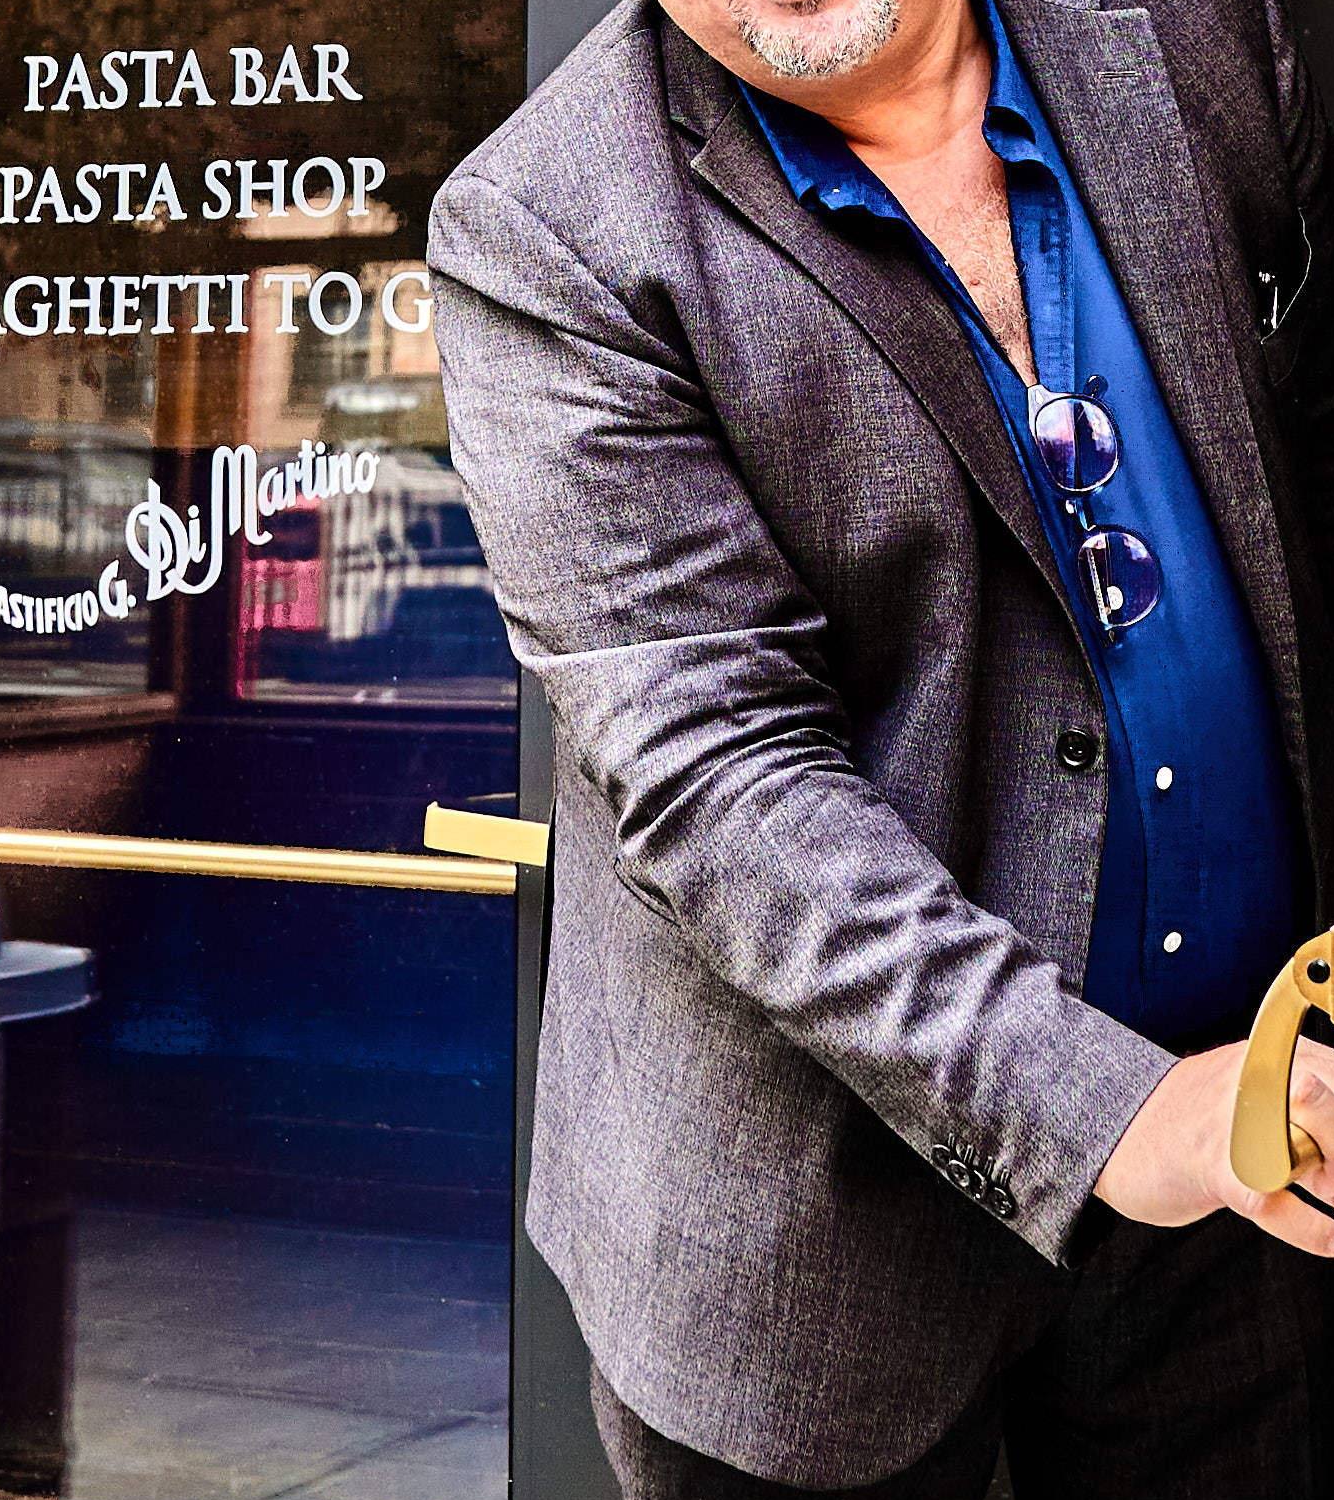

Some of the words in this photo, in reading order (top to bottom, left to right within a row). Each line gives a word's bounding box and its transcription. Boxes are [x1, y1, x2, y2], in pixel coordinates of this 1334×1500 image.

[23, 48, 216, 111] PASTA
[230, 43, 363, 103] BAR
[202, 156, 387, 219] SHOP
[264, 271, 362, 334] TO
[381, 271, 434, 333] G
[98, 560, 136, 618] G.
[124, 478, 208, 602] Di
[184, 438, 380, 594] Martino
